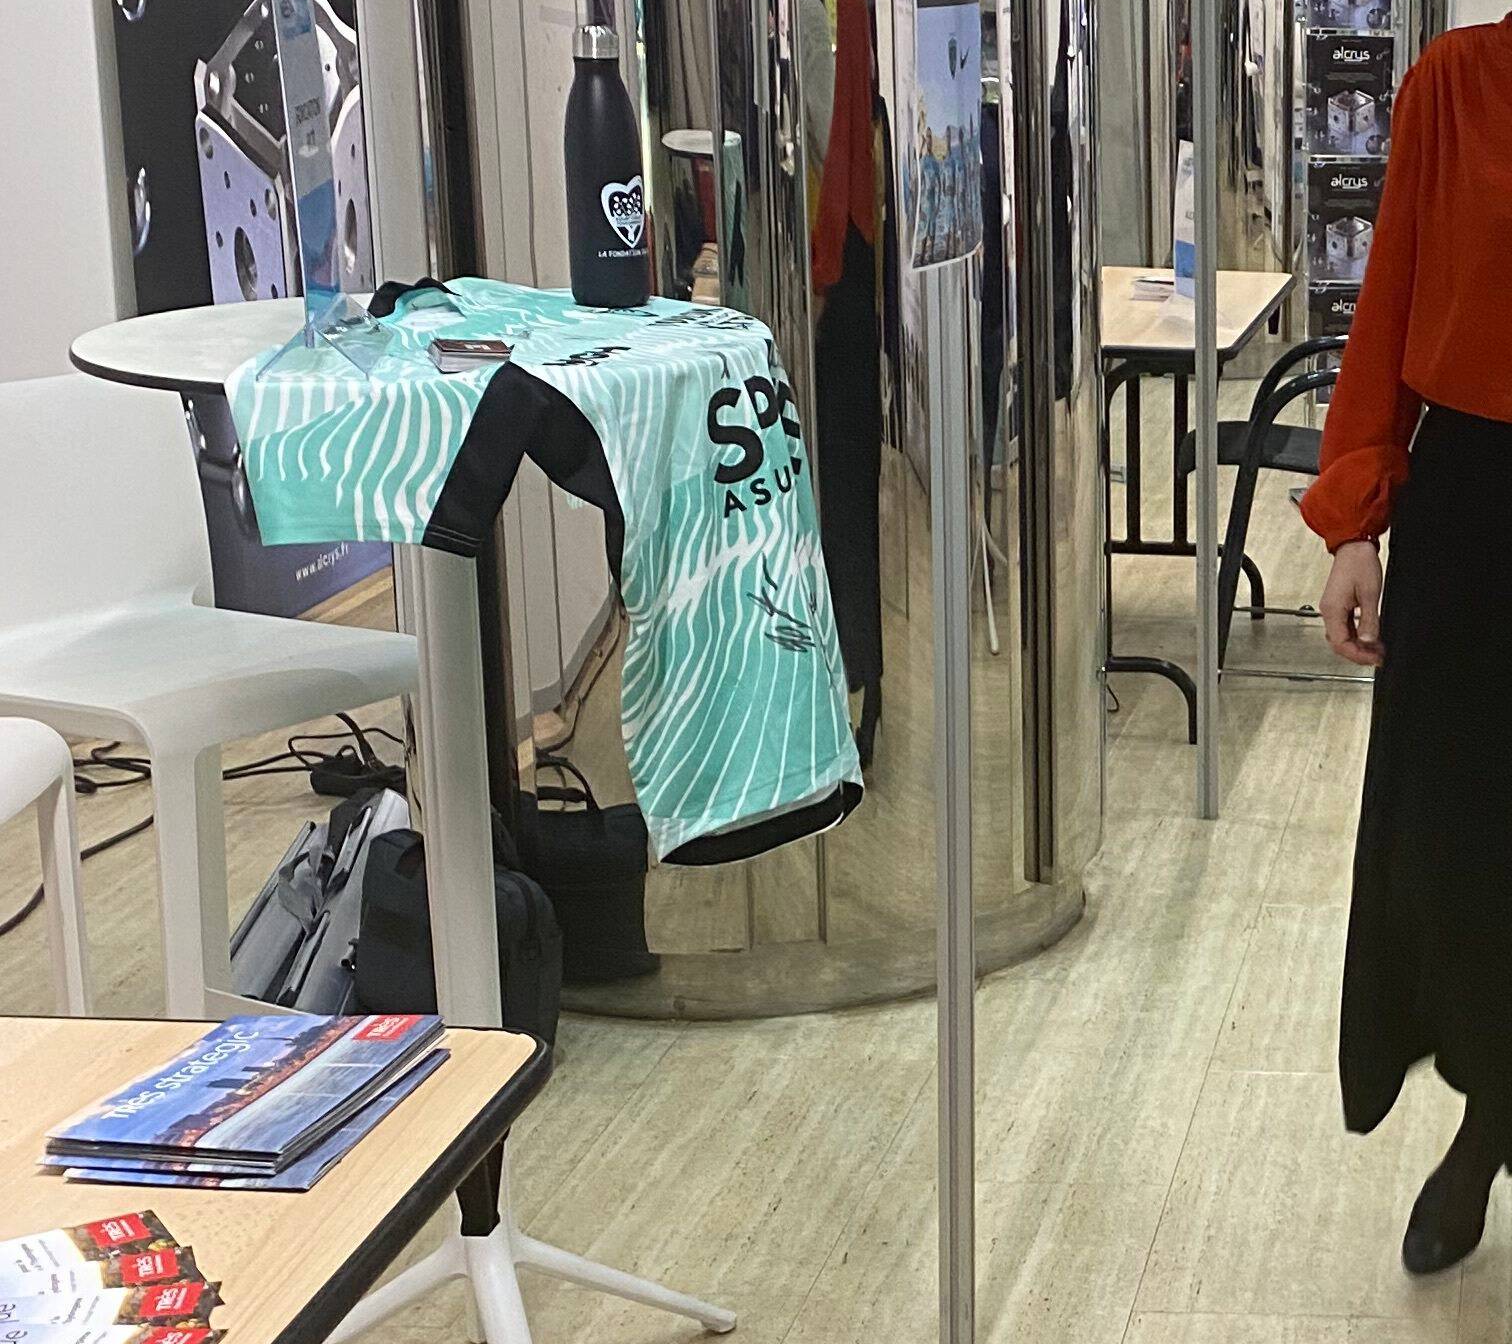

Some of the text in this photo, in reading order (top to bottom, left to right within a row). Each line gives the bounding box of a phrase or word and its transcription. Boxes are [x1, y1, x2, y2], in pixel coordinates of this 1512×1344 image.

[1333, 46, 1371, 62] alcrys
[1331, 174, 1367, 189] alcrys
[157, 1029, 260, 1091] strategic
